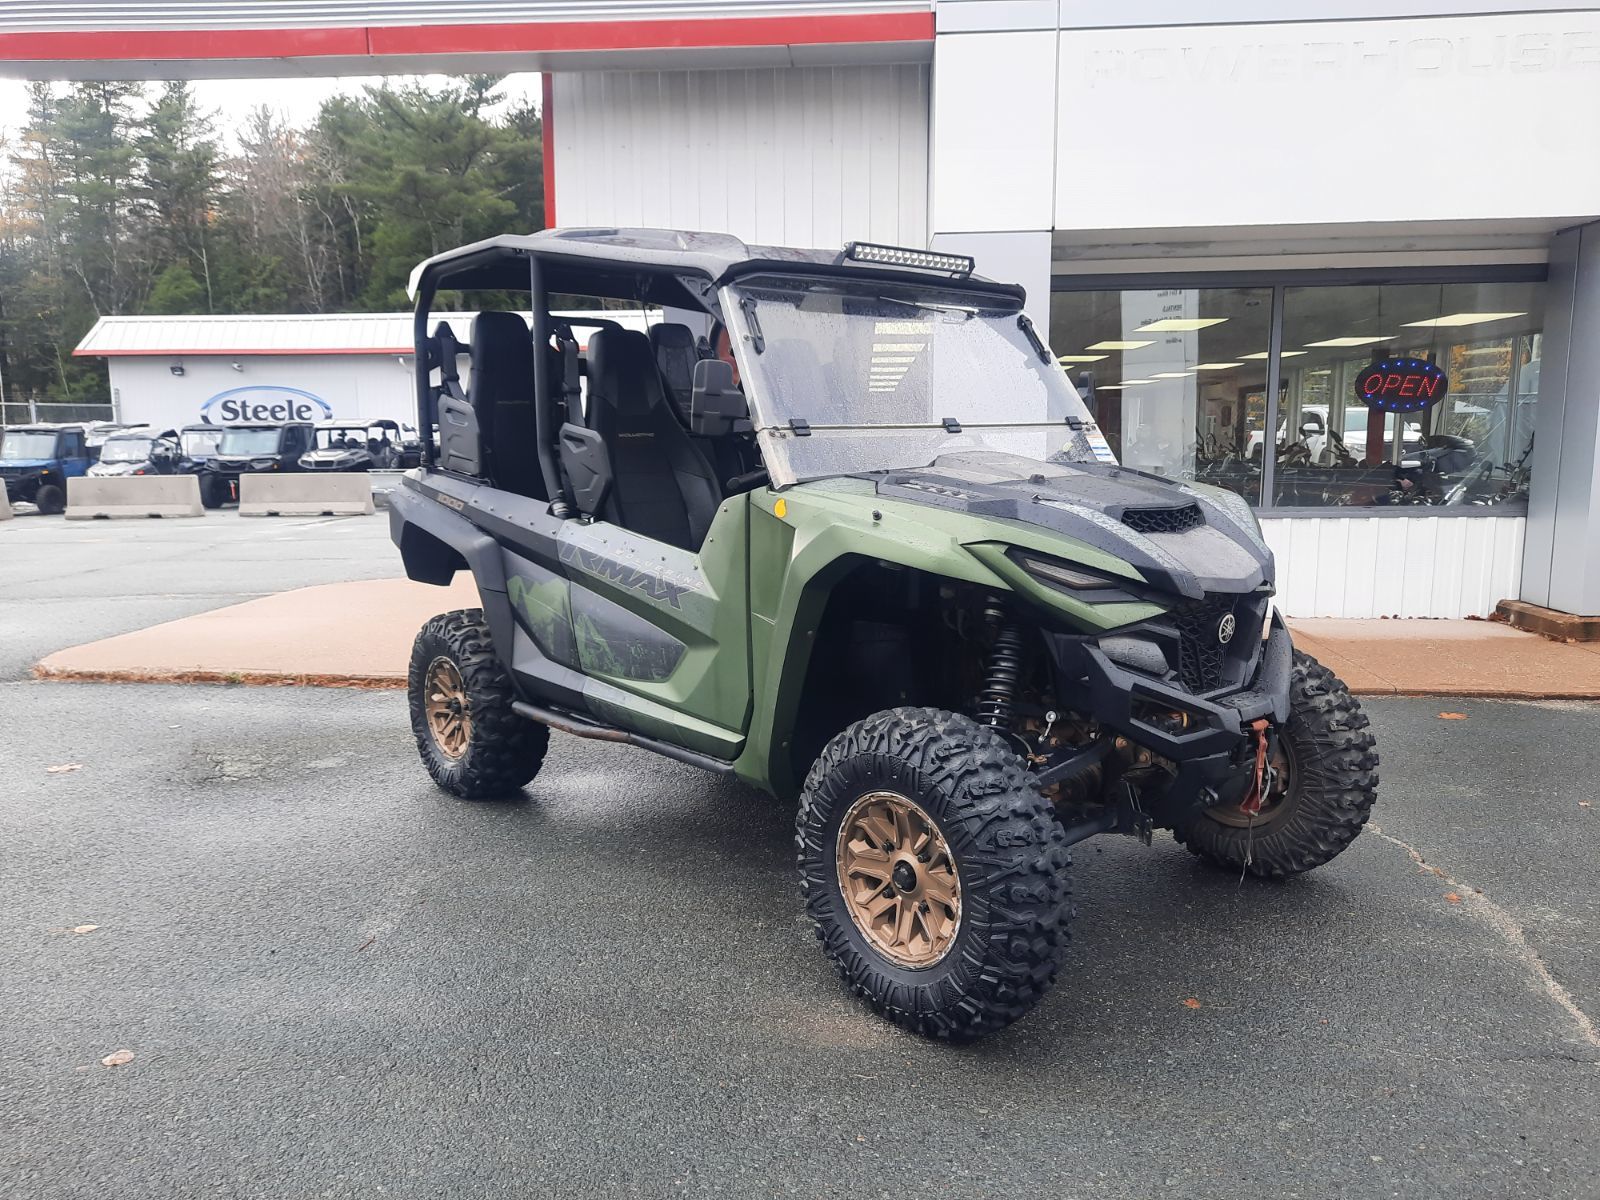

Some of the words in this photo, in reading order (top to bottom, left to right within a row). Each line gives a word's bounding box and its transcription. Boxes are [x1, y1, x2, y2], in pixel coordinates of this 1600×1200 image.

[1083, 31, 1600, 87] POWERHOUSE
[1363, 373, 1440, 397] OPEN
[221, 400, 313, 421] Steele
[559, 542, 701, 611] RMAX
